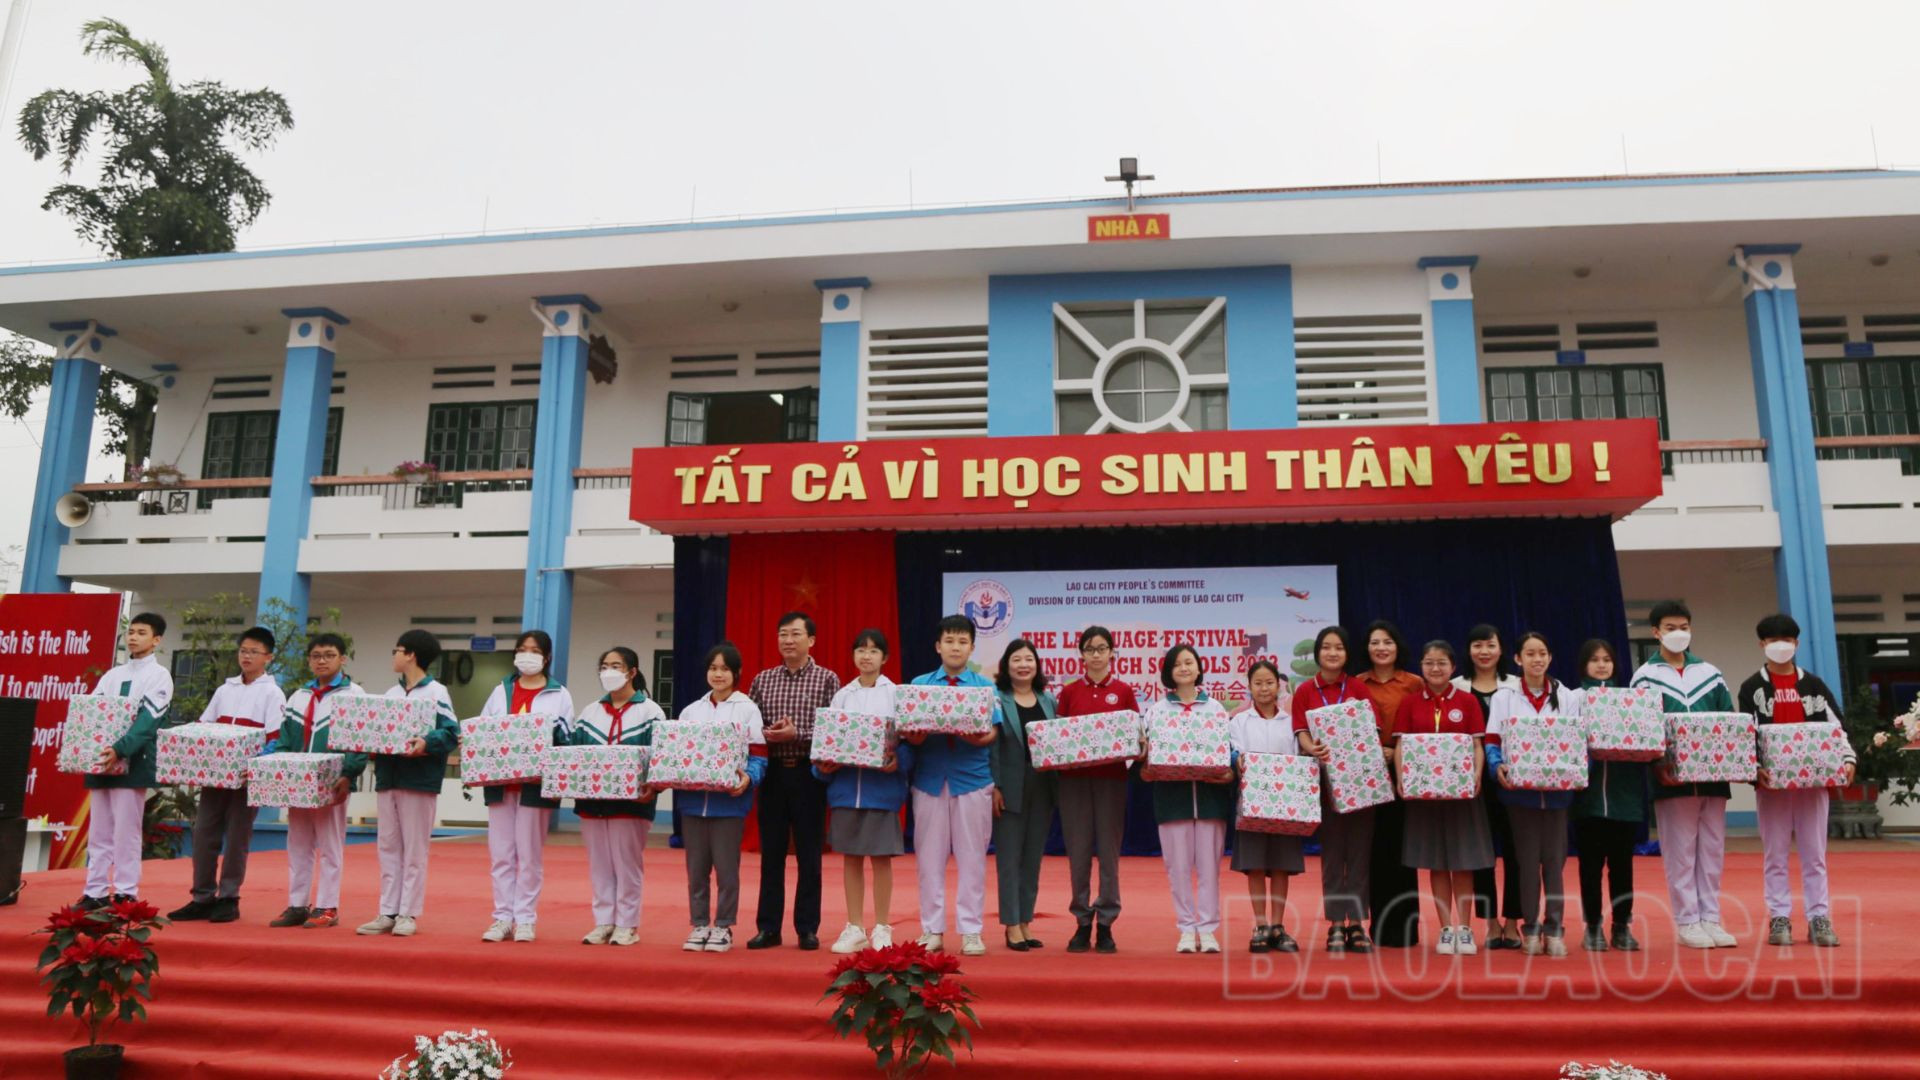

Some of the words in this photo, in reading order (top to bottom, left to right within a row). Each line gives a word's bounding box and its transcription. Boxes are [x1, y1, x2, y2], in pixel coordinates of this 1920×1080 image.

[1096, 216, 1139, 237] NHÀ
[1145, 218, 1160, 235] A
[675, 448, 771, 505] TẤT
[791, 445, 867, 502] CẢ
[883, 447, 938, 500] VÌ
[962, 456, 1081, 508] HỌC
[1101, 451, 1247, 496] SINH
[1267, 437, 1433, 491] THÂN
[1455, 432, 1572, 485] YÊU
[1066, 582, 1081, 591] LAO
[1083, 581, 1097, 591] CAI
[1098, 581, 1116, 591] CITY
[1158, 580, 1205, 590] COMMITTEE
[1028, 596, 1063, 606] DIVISION
[1065, 596, 1075, 605] OF
[1077, 596, 1121, 605] EDUCATION
[1123, 595, 1140, 605] AND
[1142, 595, 1180, 604] TRAINING
[1182, 594, 1192, 604] OF
[1193, 594, 1209, 604] LAO
[1210, 594, 1225, 603] CAI
[1226, 593, 1244, 603] CITY
[21, 630, 35, 655] is
[39, 630, 61, 656] the
[64, 630, 91, 655] link
[1022, 631, 1057, 649] THE
[1163, 629, 1249, 648] FESTIVAL
[7, 675, 22, 698] to
